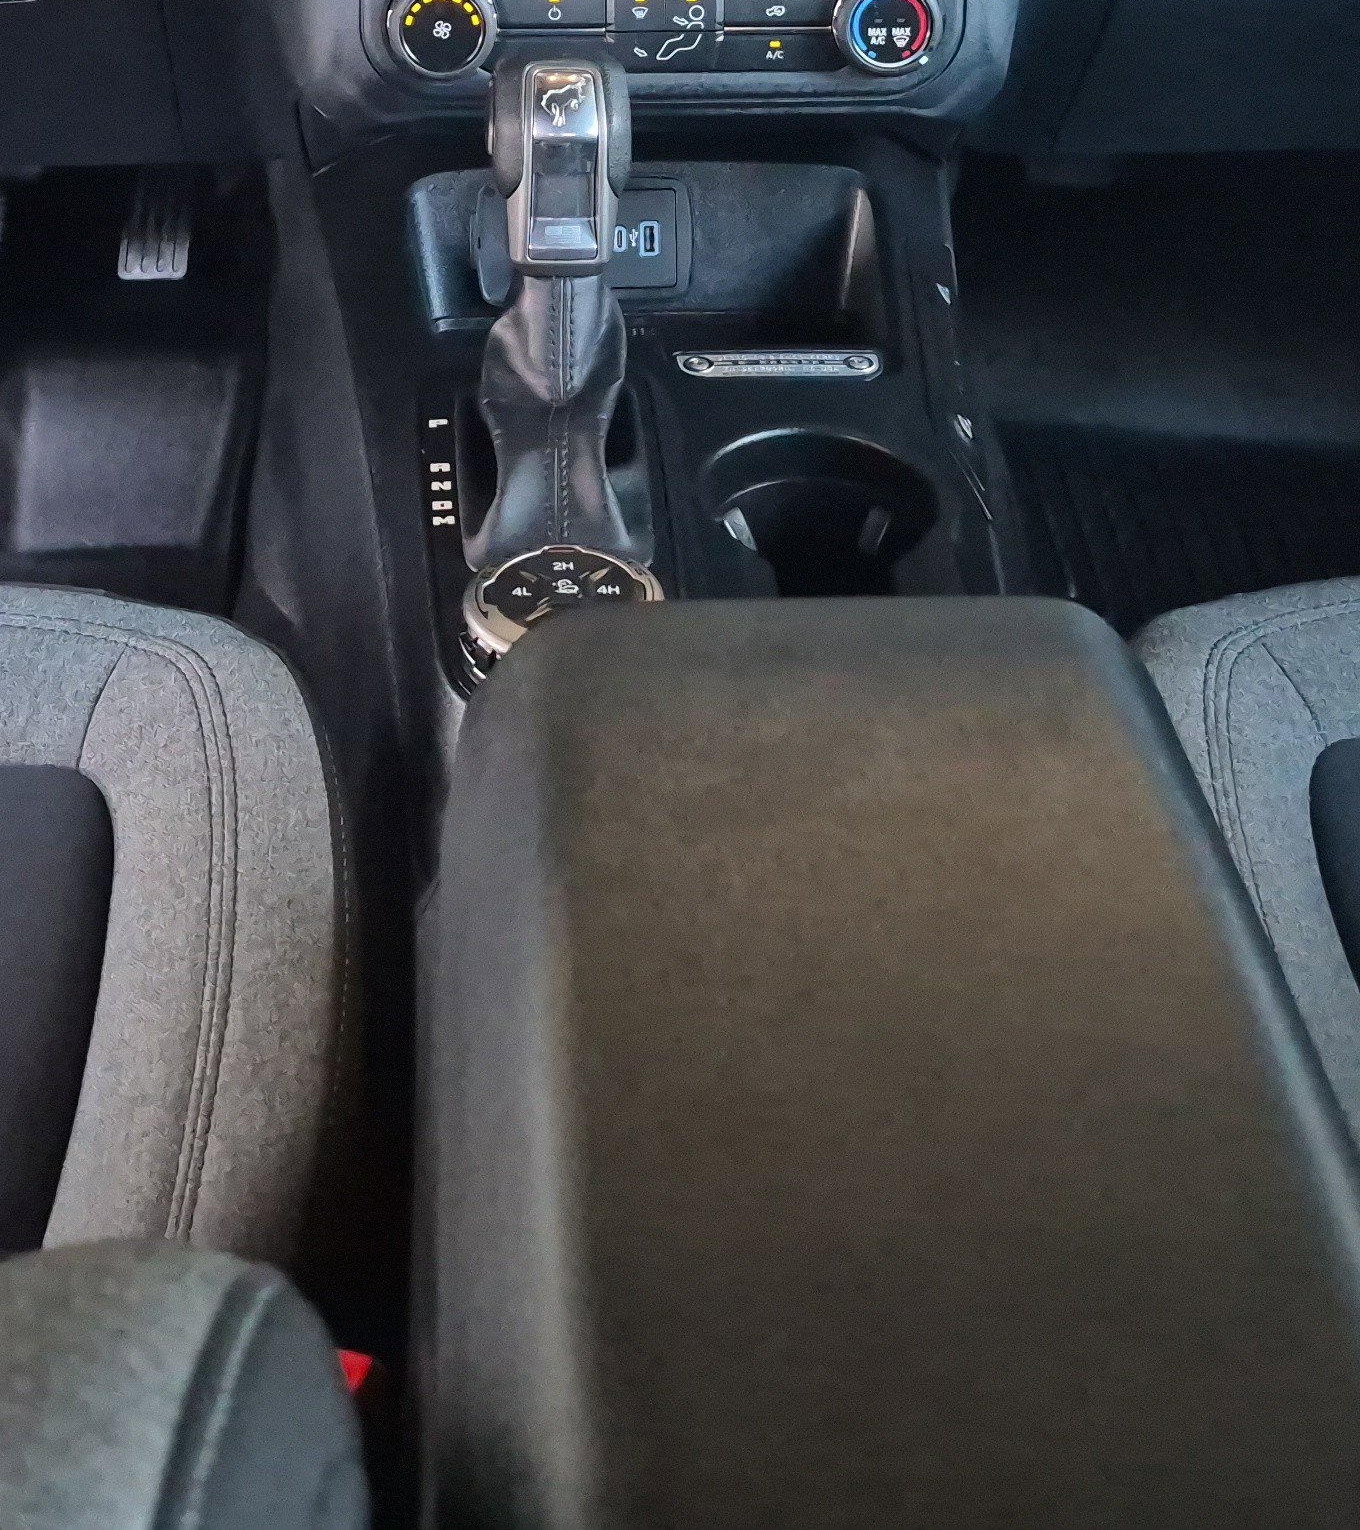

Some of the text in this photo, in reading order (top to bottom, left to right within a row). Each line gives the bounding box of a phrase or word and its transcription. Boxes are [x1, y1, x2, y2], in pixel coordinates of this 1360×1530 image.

[867, 27, 888, 37] MAX
[891, 27, 912, 37] MAX
[870, 36, 886, 45] A/C
[766, 50, 784, 60] A/C
[553, 561, 575, 571] 2H
[512, 586, 533, 596] 4L
[596, 584, 621, 595] 4H
